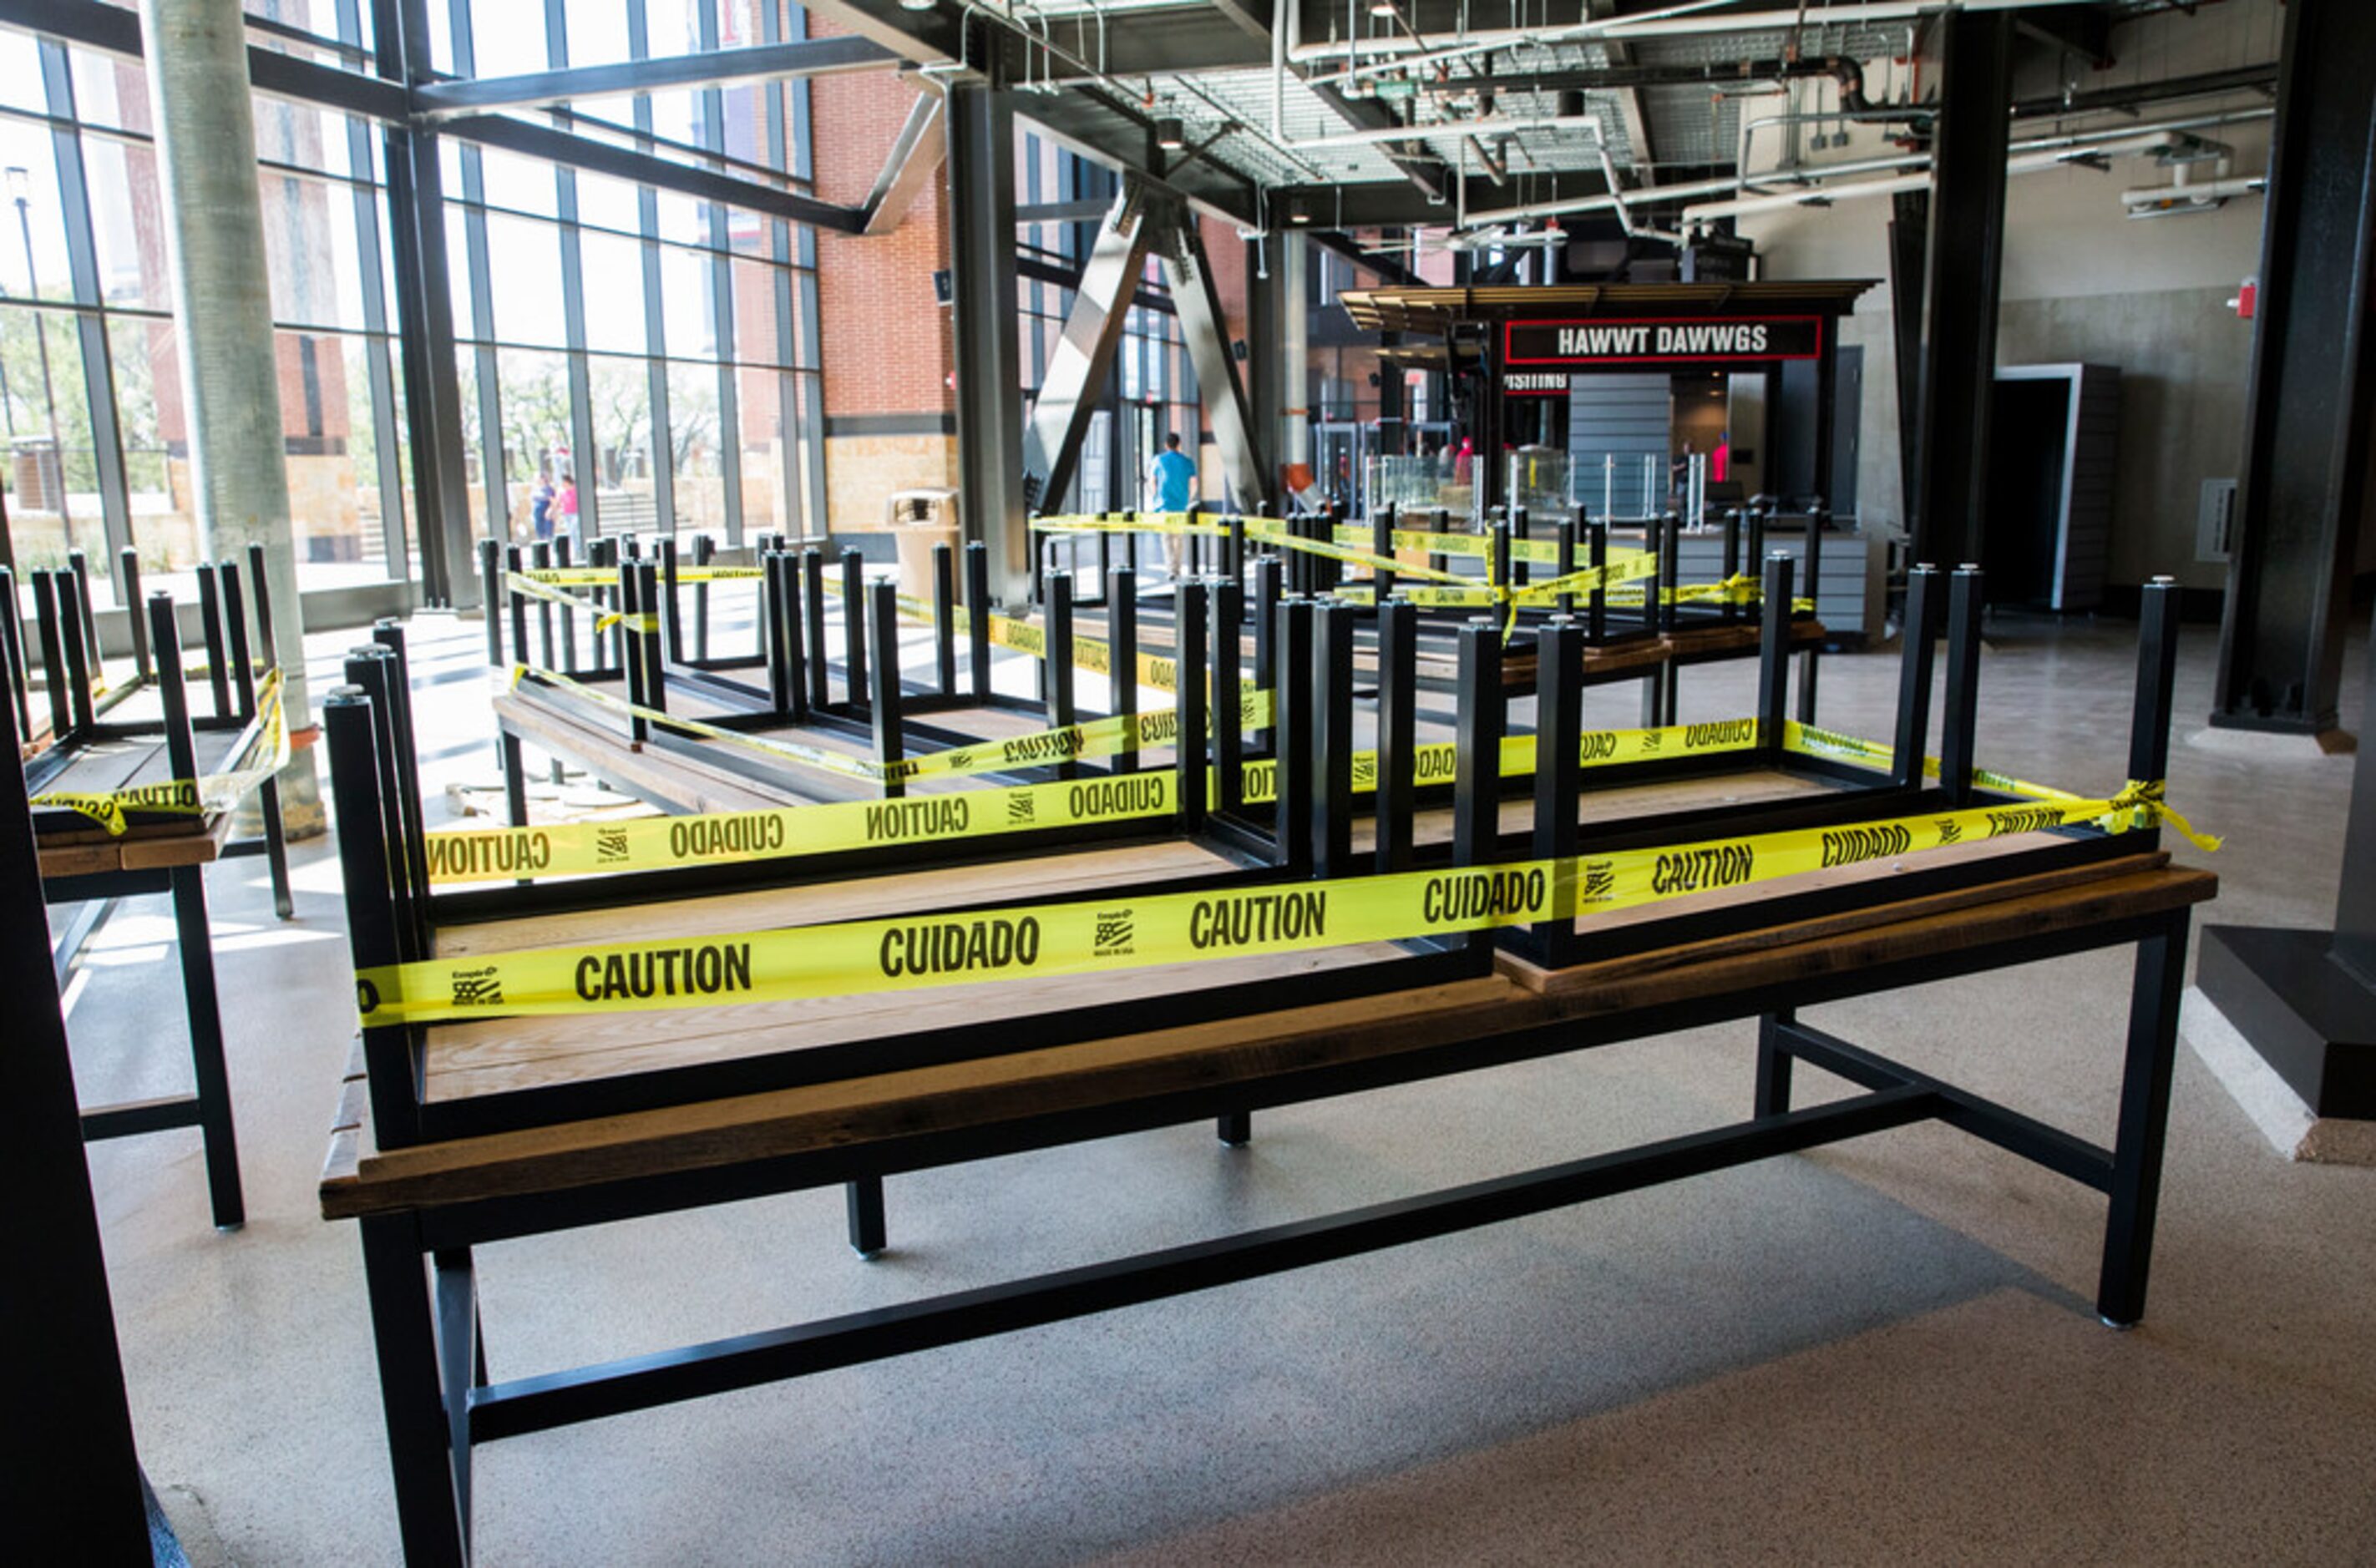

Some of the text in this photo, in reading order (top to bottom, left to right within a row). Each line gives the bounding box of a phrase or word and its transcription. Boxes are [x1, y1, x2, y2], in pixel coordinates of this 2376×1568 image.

[1558, 325, 1767, 355] HAWWT DAWWGS
[575, 943, 752, 1001] CAUTION
[879, 915, 1040, 977] CUIDADO
[1190, 891, 1326, 949] CAUTION
[1424, 868, 1544, 923] CUIDADO
[1651, 844, 1754, 896] CAUTION
[1821, 824, 1912, 867] CUIDADO
